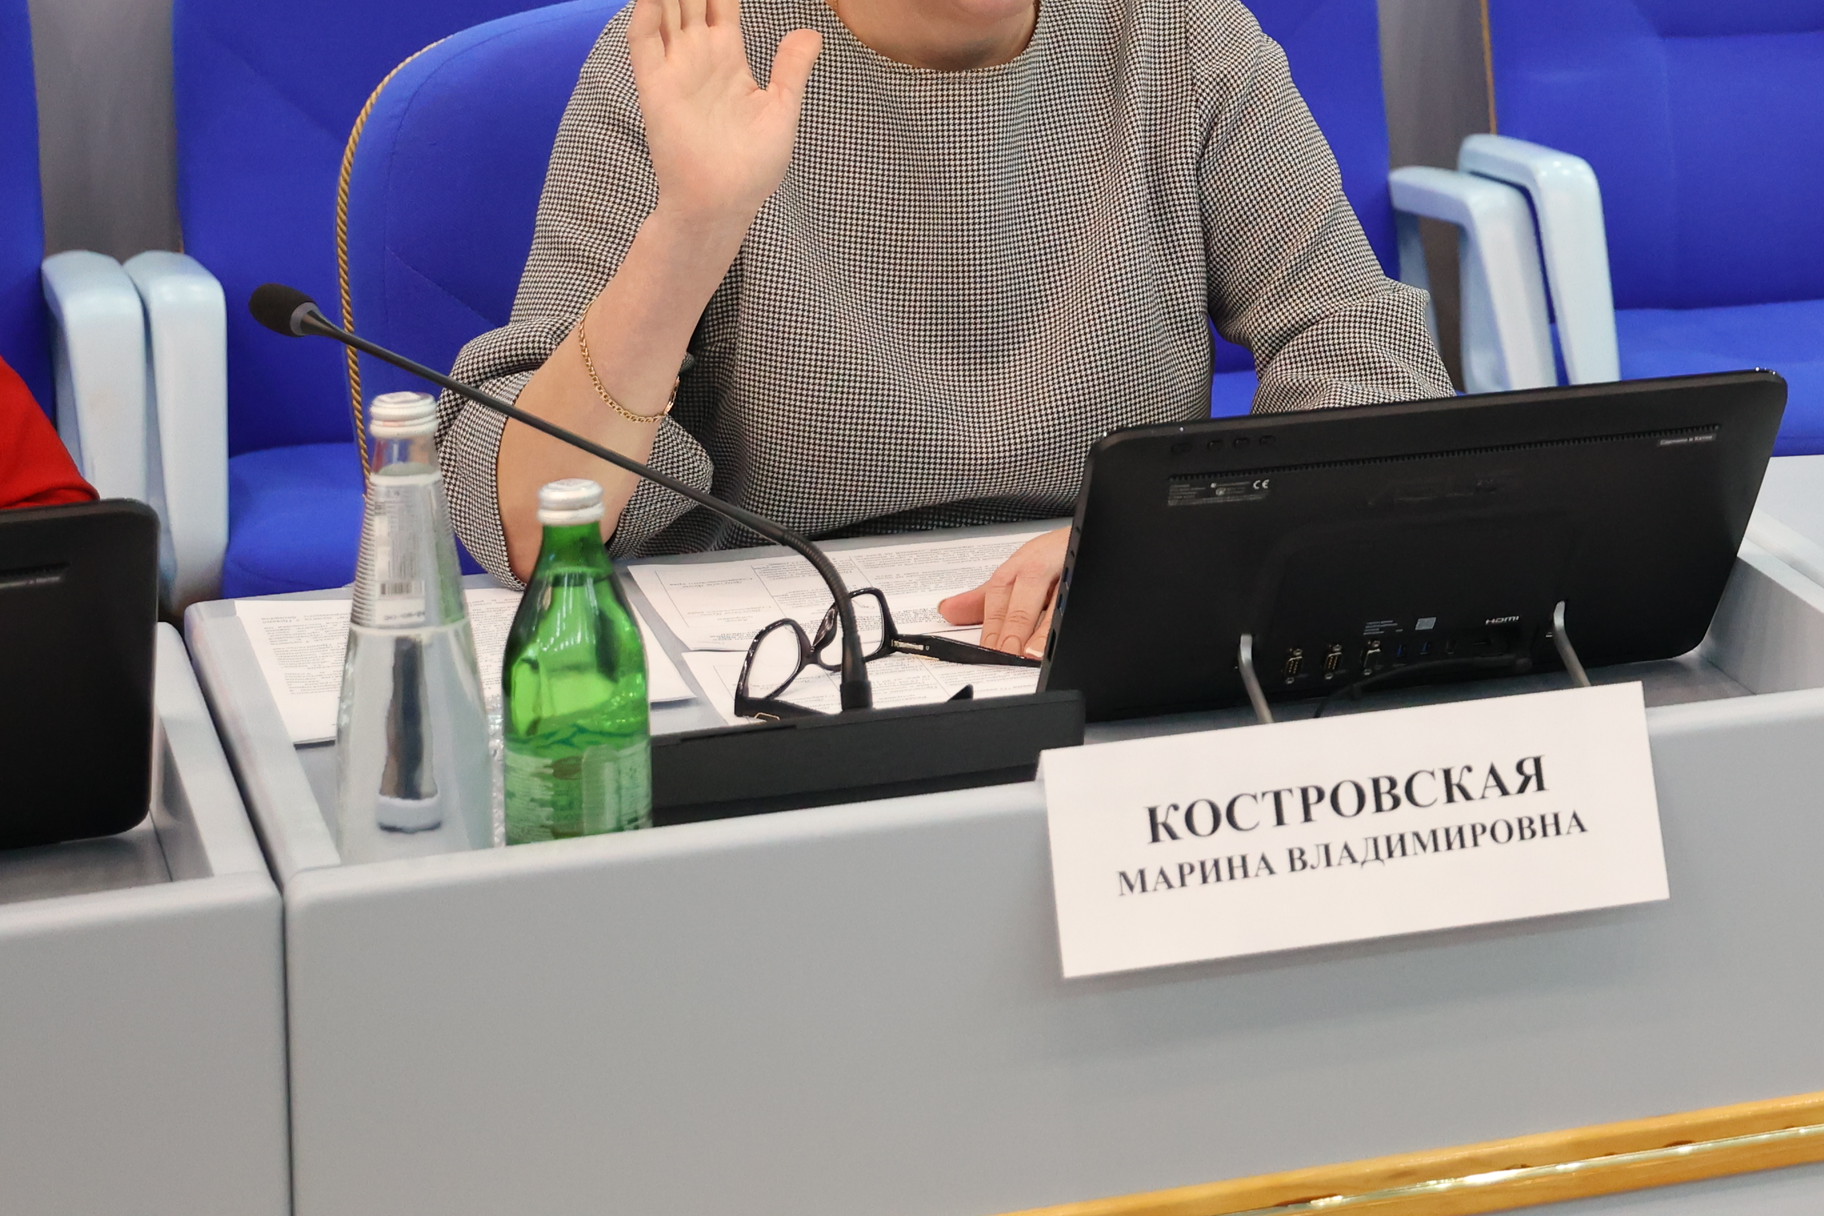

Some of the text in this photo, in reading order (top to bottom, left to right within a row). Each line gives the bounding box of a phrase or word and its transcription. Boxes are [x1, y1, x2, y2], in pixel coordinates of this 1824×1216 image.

[1144, 754, 1549, 845] КОСТРОВСКАЯ
[1116, 809, 1589, 896] МАРИНА ВЛАДИМИРОВНА
